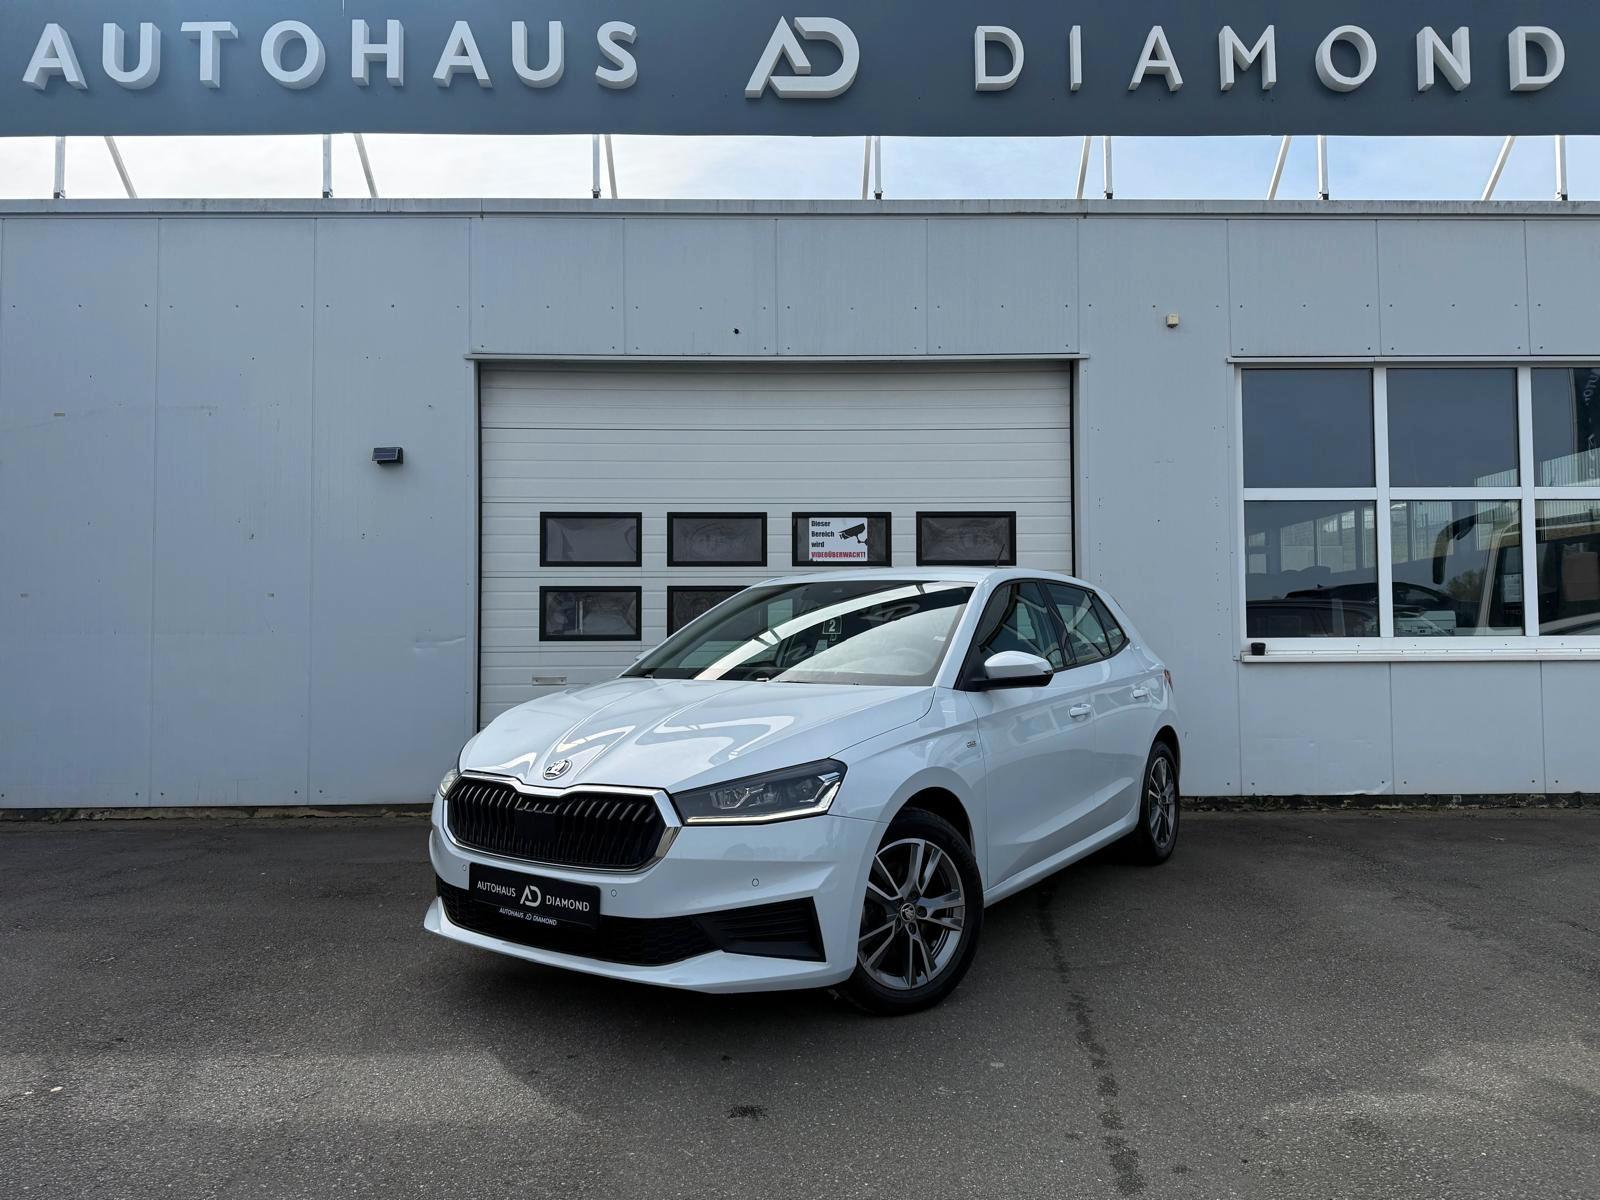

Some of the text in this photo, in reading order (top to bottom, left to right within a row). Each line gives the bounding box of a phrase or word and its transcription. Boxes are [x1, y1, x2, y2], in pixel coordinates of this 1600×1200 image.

[22, 20, 638, 90] AUTOHAUS
[974, 25, 1566, 92] DIAMOND
[476, 880, 516, 897] AUTOHAUS
[545, 895, 590, 912] DIAMOND
[498, 907, 524, 919] AUTOHAUS
[532, 915, 557, 926] DIAMOND
